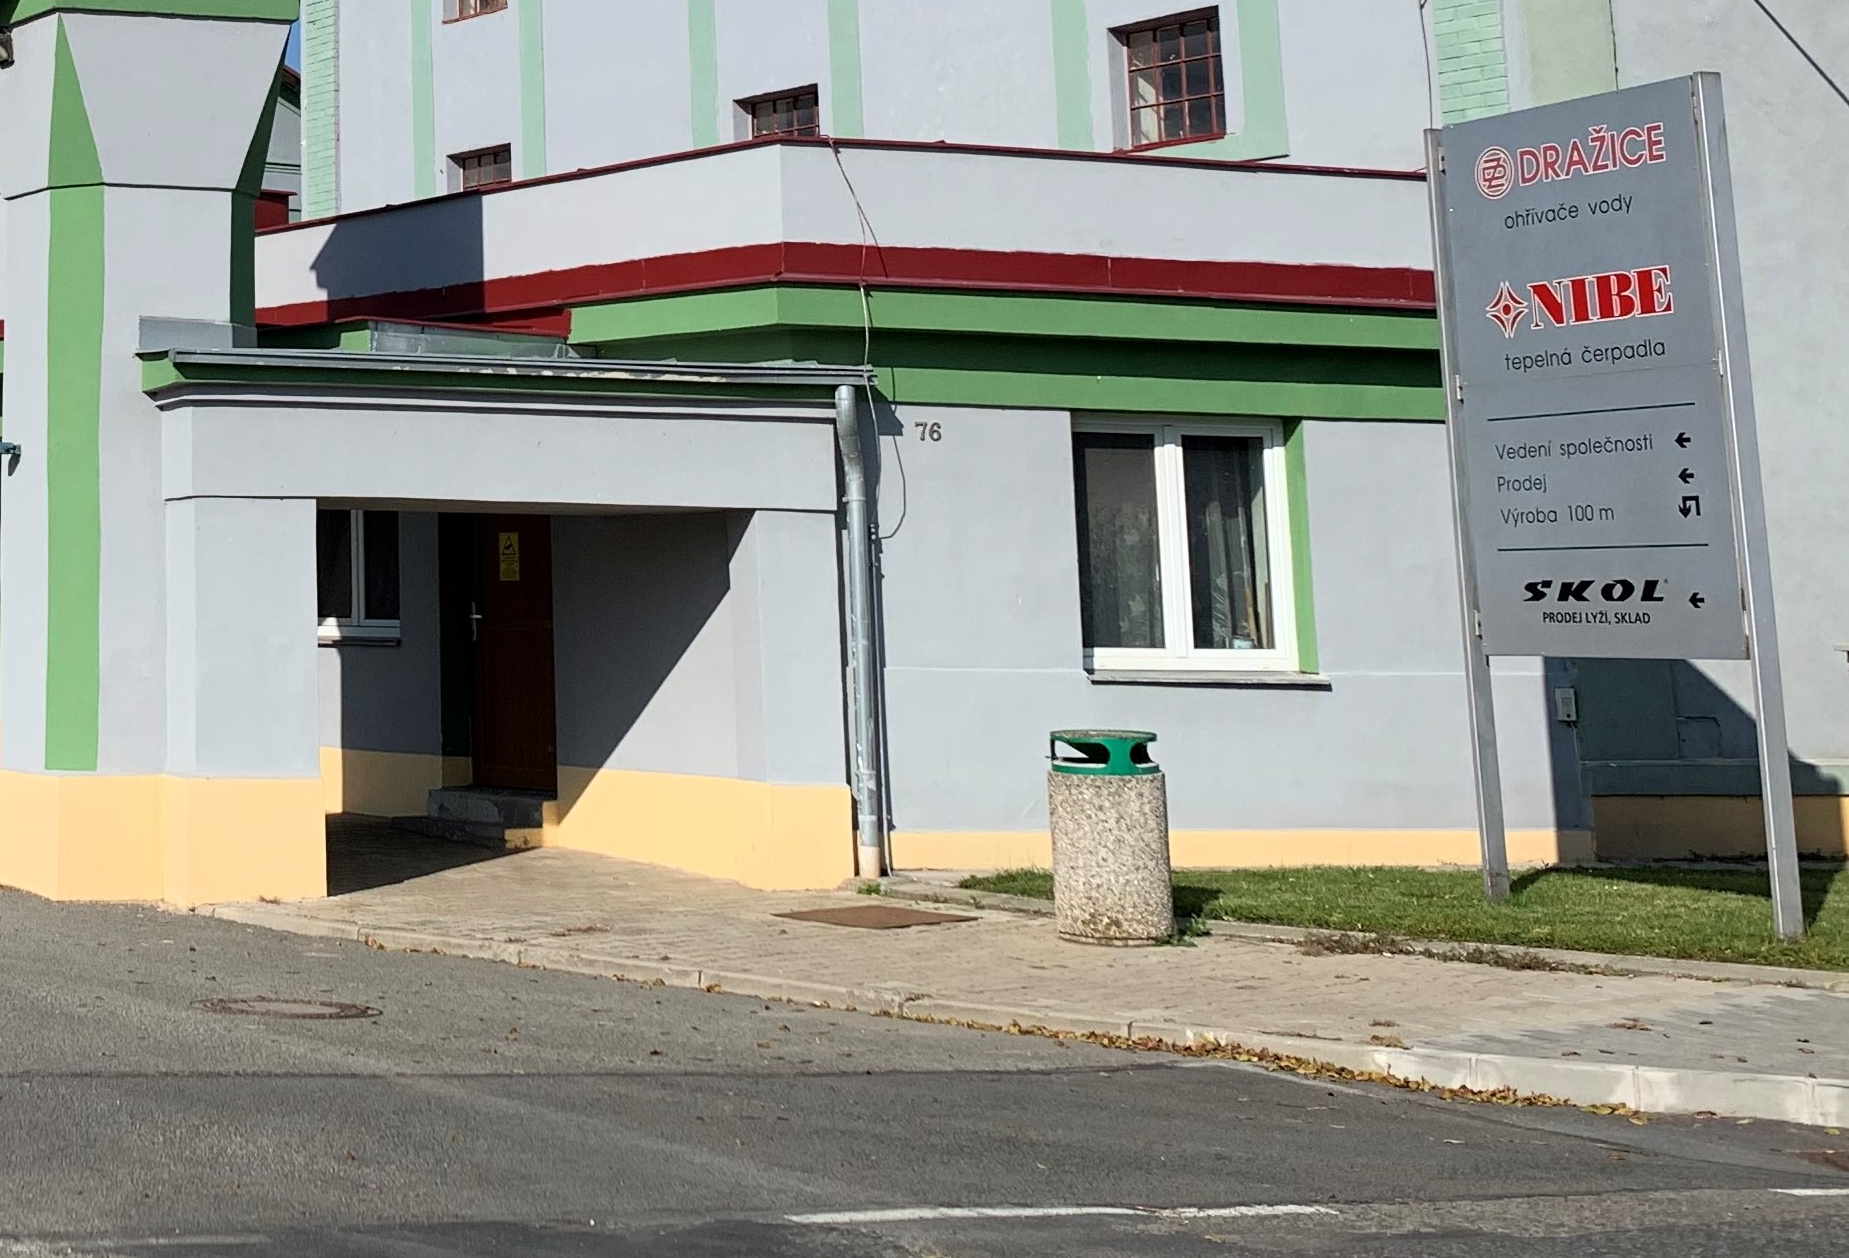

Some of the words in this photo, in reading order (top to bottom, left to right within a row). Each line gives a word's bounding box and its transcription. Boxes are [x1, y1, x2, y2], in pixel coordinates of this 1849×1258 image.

[1518, 122, 1667, 187] DRAŽICE
[1588, 193, 1632, 215] vody
[1527, 265, 1675, 330] NIBE
[1505, 347, 1572, 373] tepelná
[1581, 339, 1665, 364] čerpadla
[914, 421, 942, 442] 76
[1495, 440, 1552, 460] Vedení
[1559, 433, 1654, 459] společnosti
[1497, 474, 1547, 494] Prodej
[1500, 507, 1558, 528] Výroba
[1567, 504, 1594, 522] 100
[1599, 508, 1615, 521] m
[1542, 611, 1583, 625] PRODEJ
[1614, 611, 1651, 624] SKLAD
